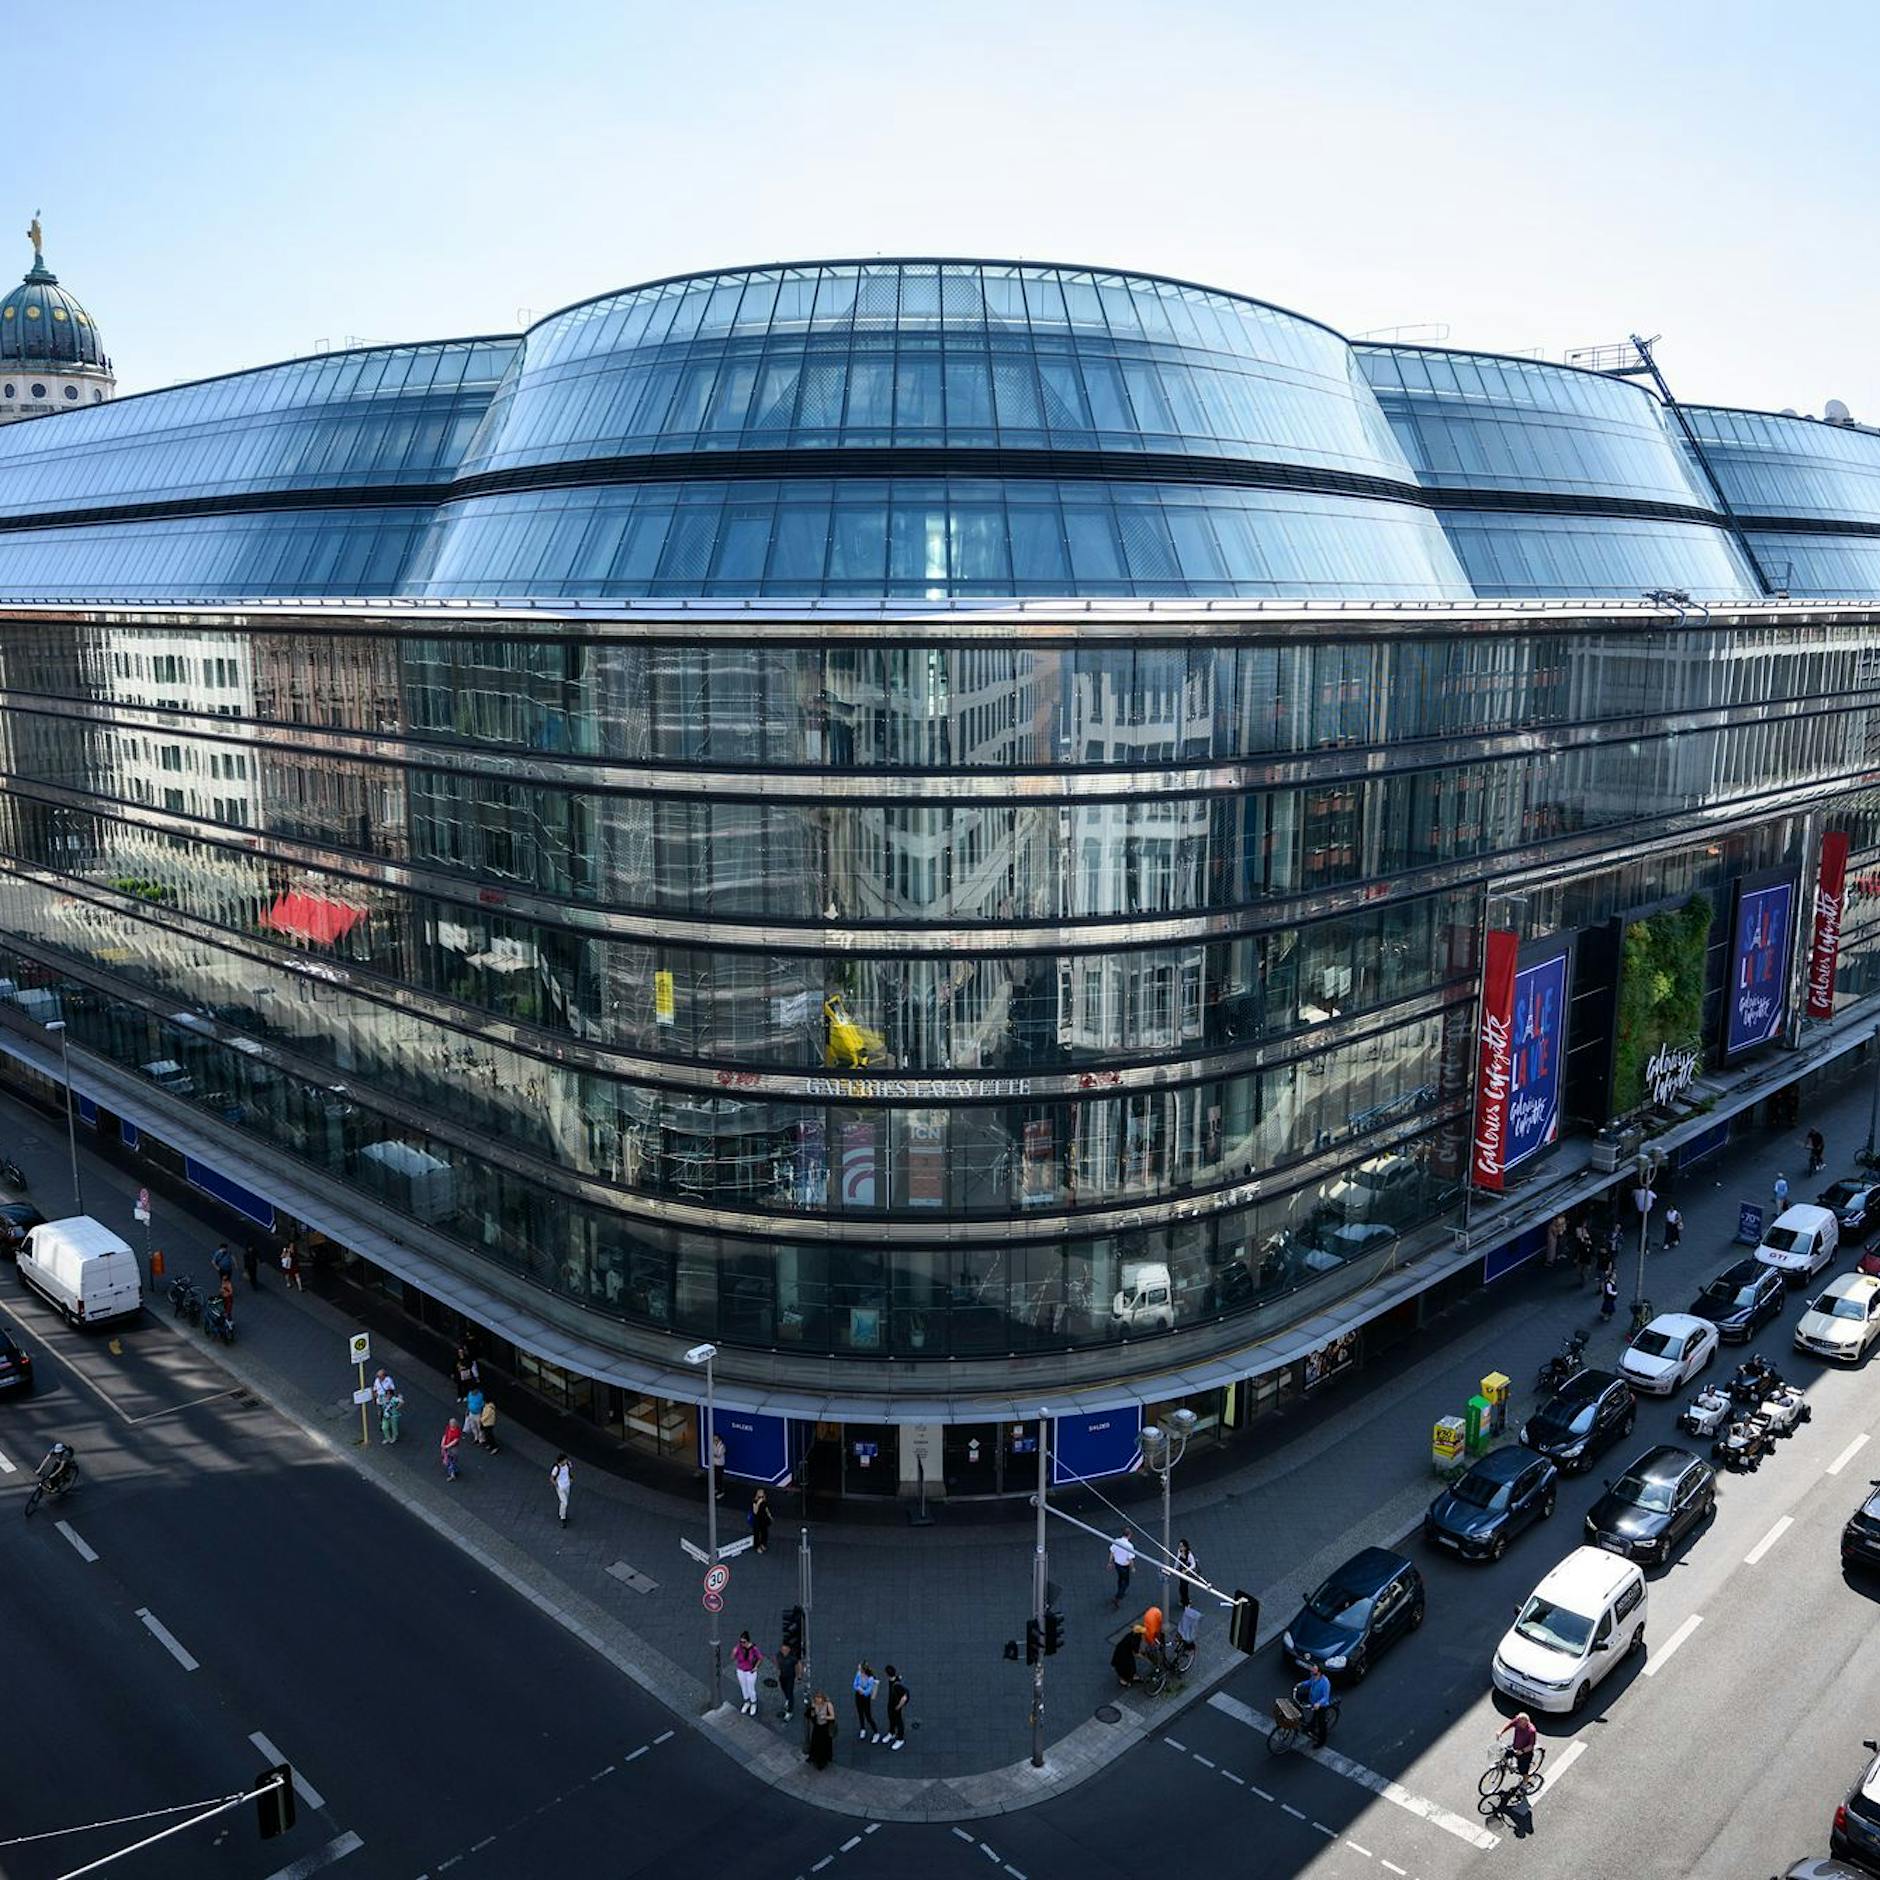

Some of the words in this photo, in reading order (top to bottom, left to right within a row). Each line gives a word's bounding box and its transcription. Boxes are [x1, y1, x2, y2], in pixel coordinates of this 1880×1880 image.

[1480, 1007, 1513, 1100] Lafayette
[805, 1078, 908, 1098] GALERIES
[913, 1078, 1032, 1098] LAFAYETTE
[1474, 1104, 1502, 1175] Galeries
[709, 1571, 724, 1588] 30
